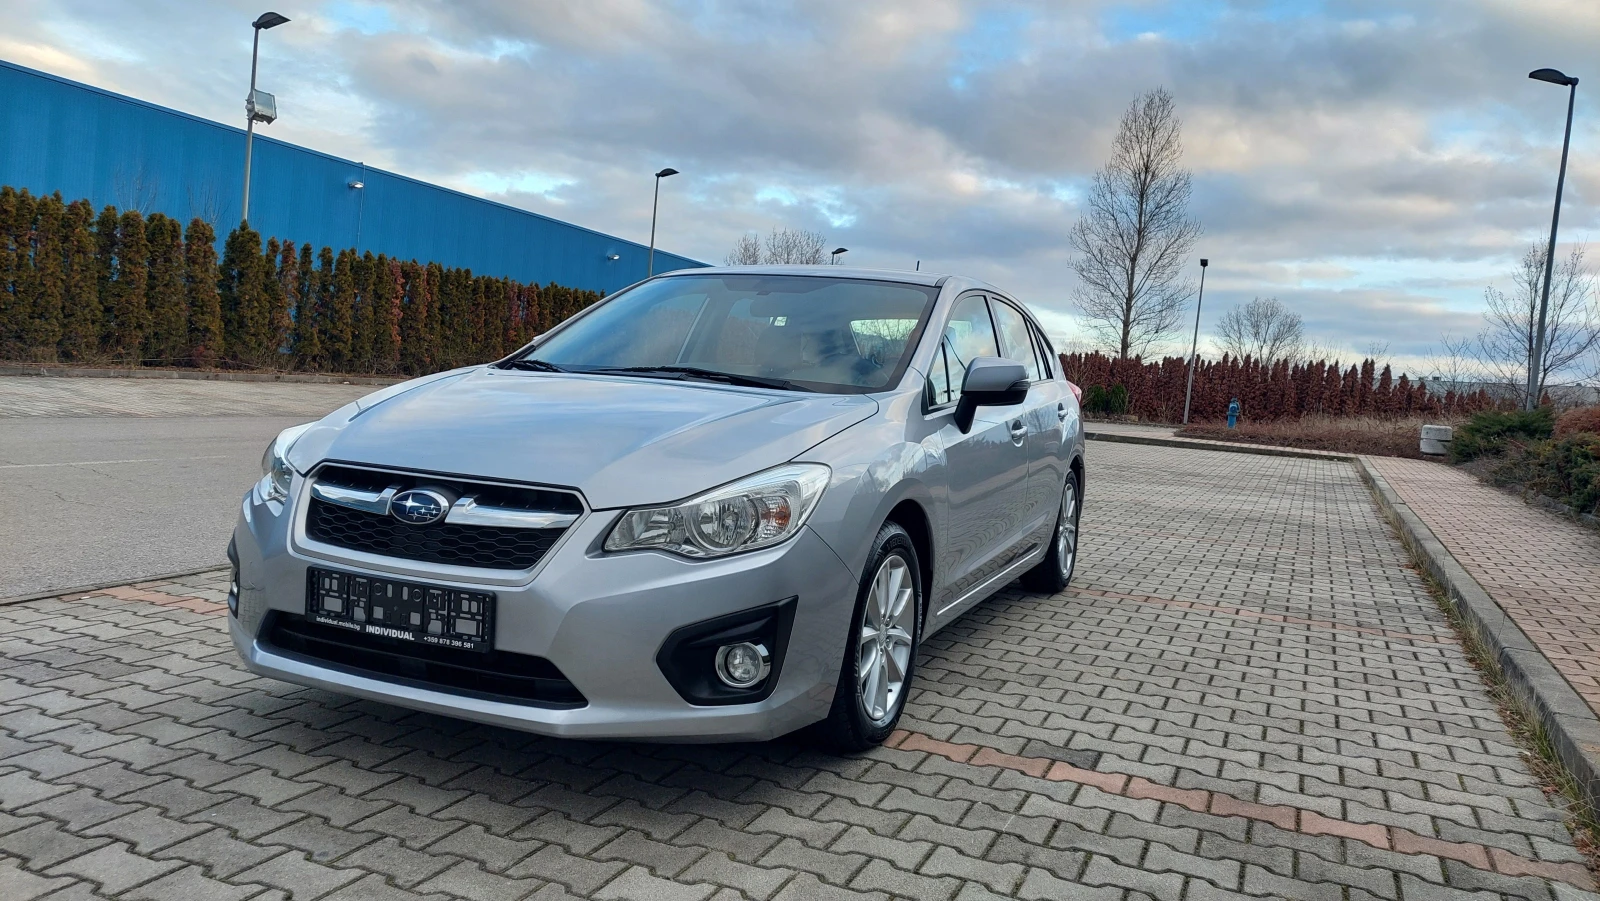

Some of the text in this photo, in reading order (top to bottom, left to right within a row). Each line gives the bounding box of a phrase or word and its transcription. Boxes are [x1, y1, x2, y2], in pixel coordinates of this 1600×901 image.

[315, 615, 361, 631] individual.mobile.bg
[365, 624, 415, 641] INDIVIDUAL
[423, 636, 438, 644] +359
[463, 641, 474, 649] 581
